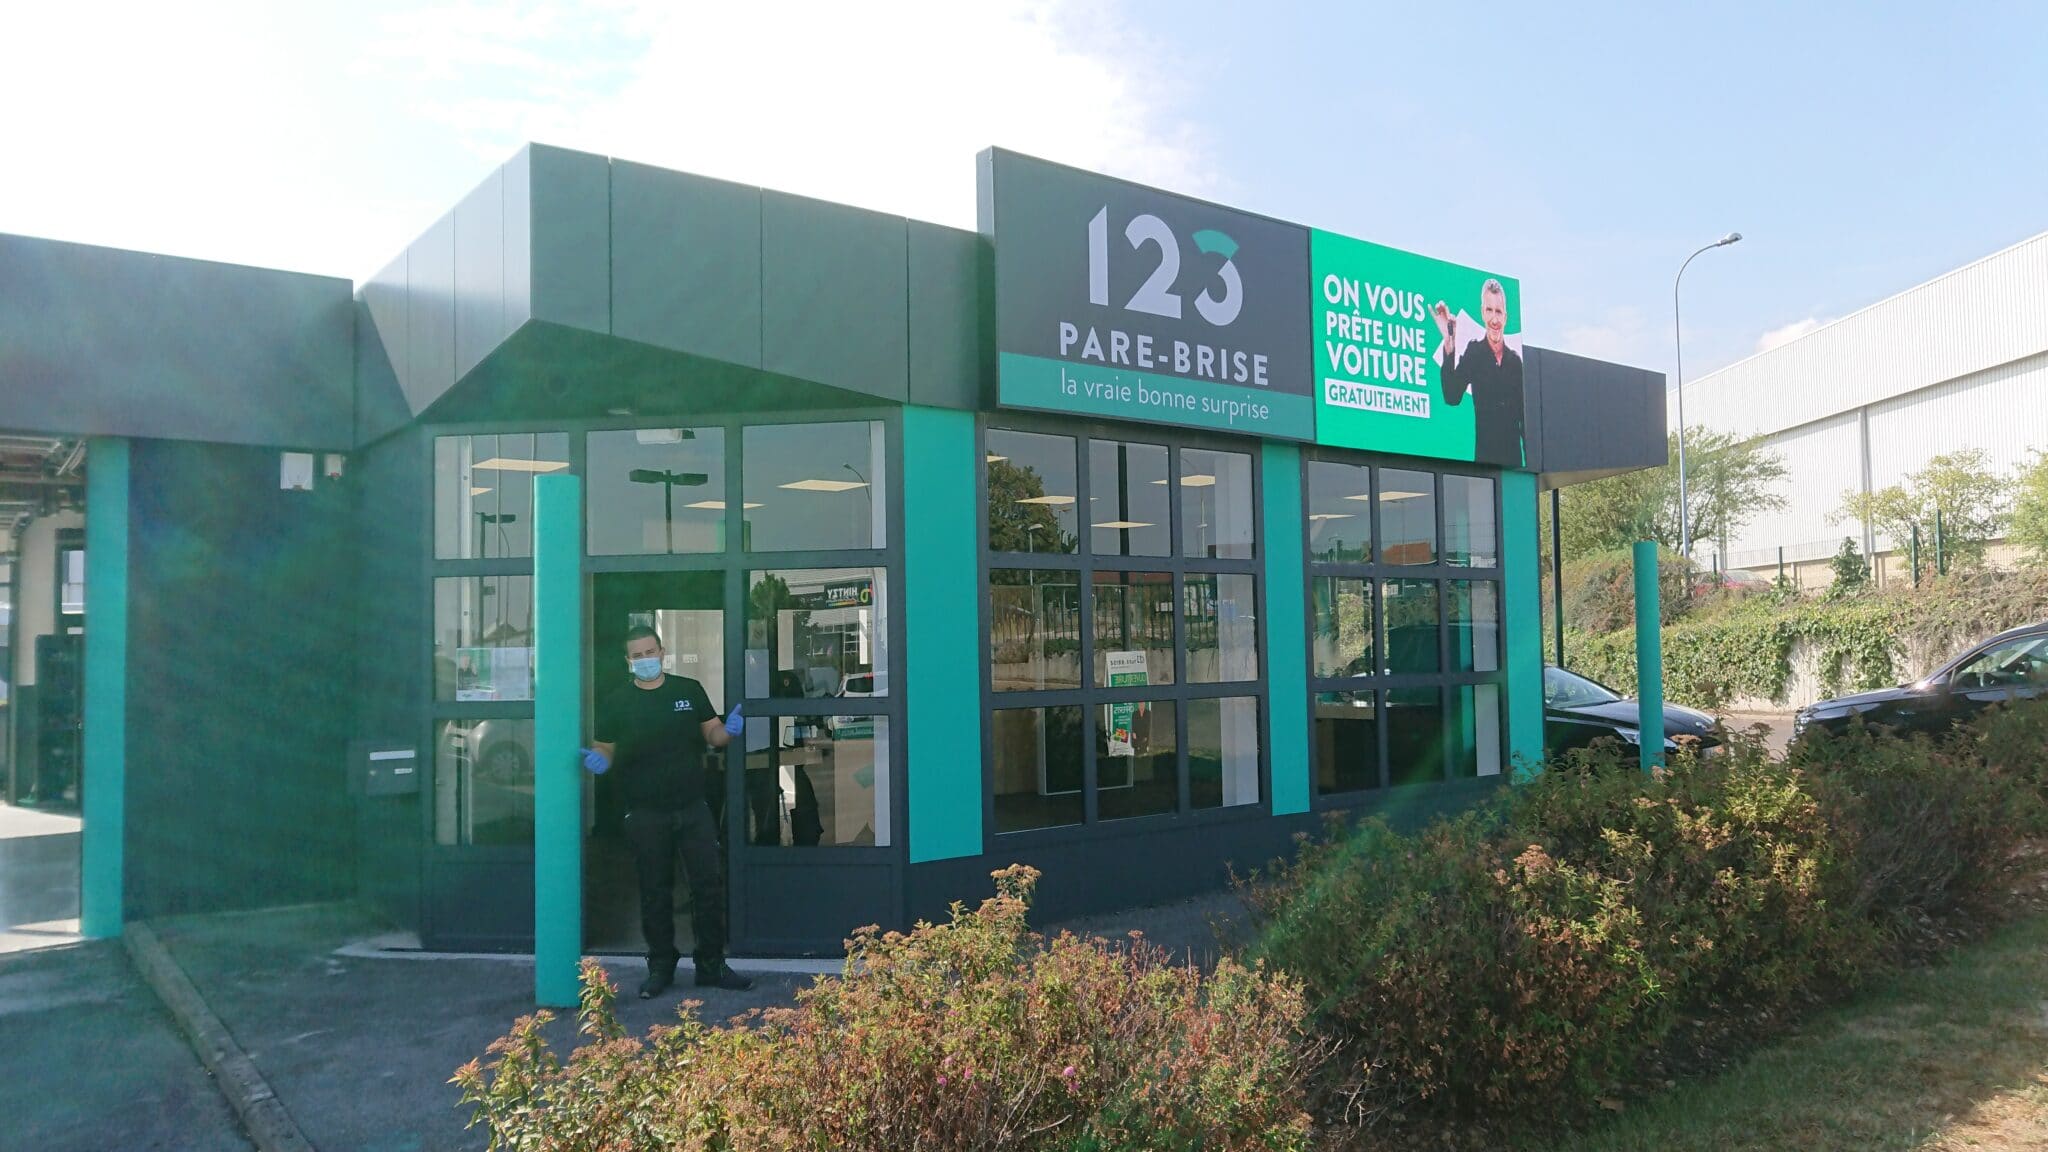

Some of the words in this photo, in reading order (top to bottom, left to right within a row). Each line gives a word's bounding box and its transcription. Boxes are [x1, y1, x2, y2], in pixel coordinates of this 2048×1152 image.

[1088, 203, 1244, 327] 123
[1323, 274, 1360, 309] ON
[1364, 282, 1426, 322] VOUS
[1059, 321, 1269, 386] PARE-BRISE
[1326, 310, 1384, 345] PRÊTE
[1387, 323, 1426, 353] UNE
[1325, 340, 1427, 387] VOITURE
[1061, 367, 1077, 396] la
[1083, 376, 1132, 401] vraie
[1137, 378, 1196, 410] bonne
[1201, 395, 1269, 425] surprise
[1328, 384, 1428, 415] GRATUITEMENT
[675, 700, 690, 708] 123
